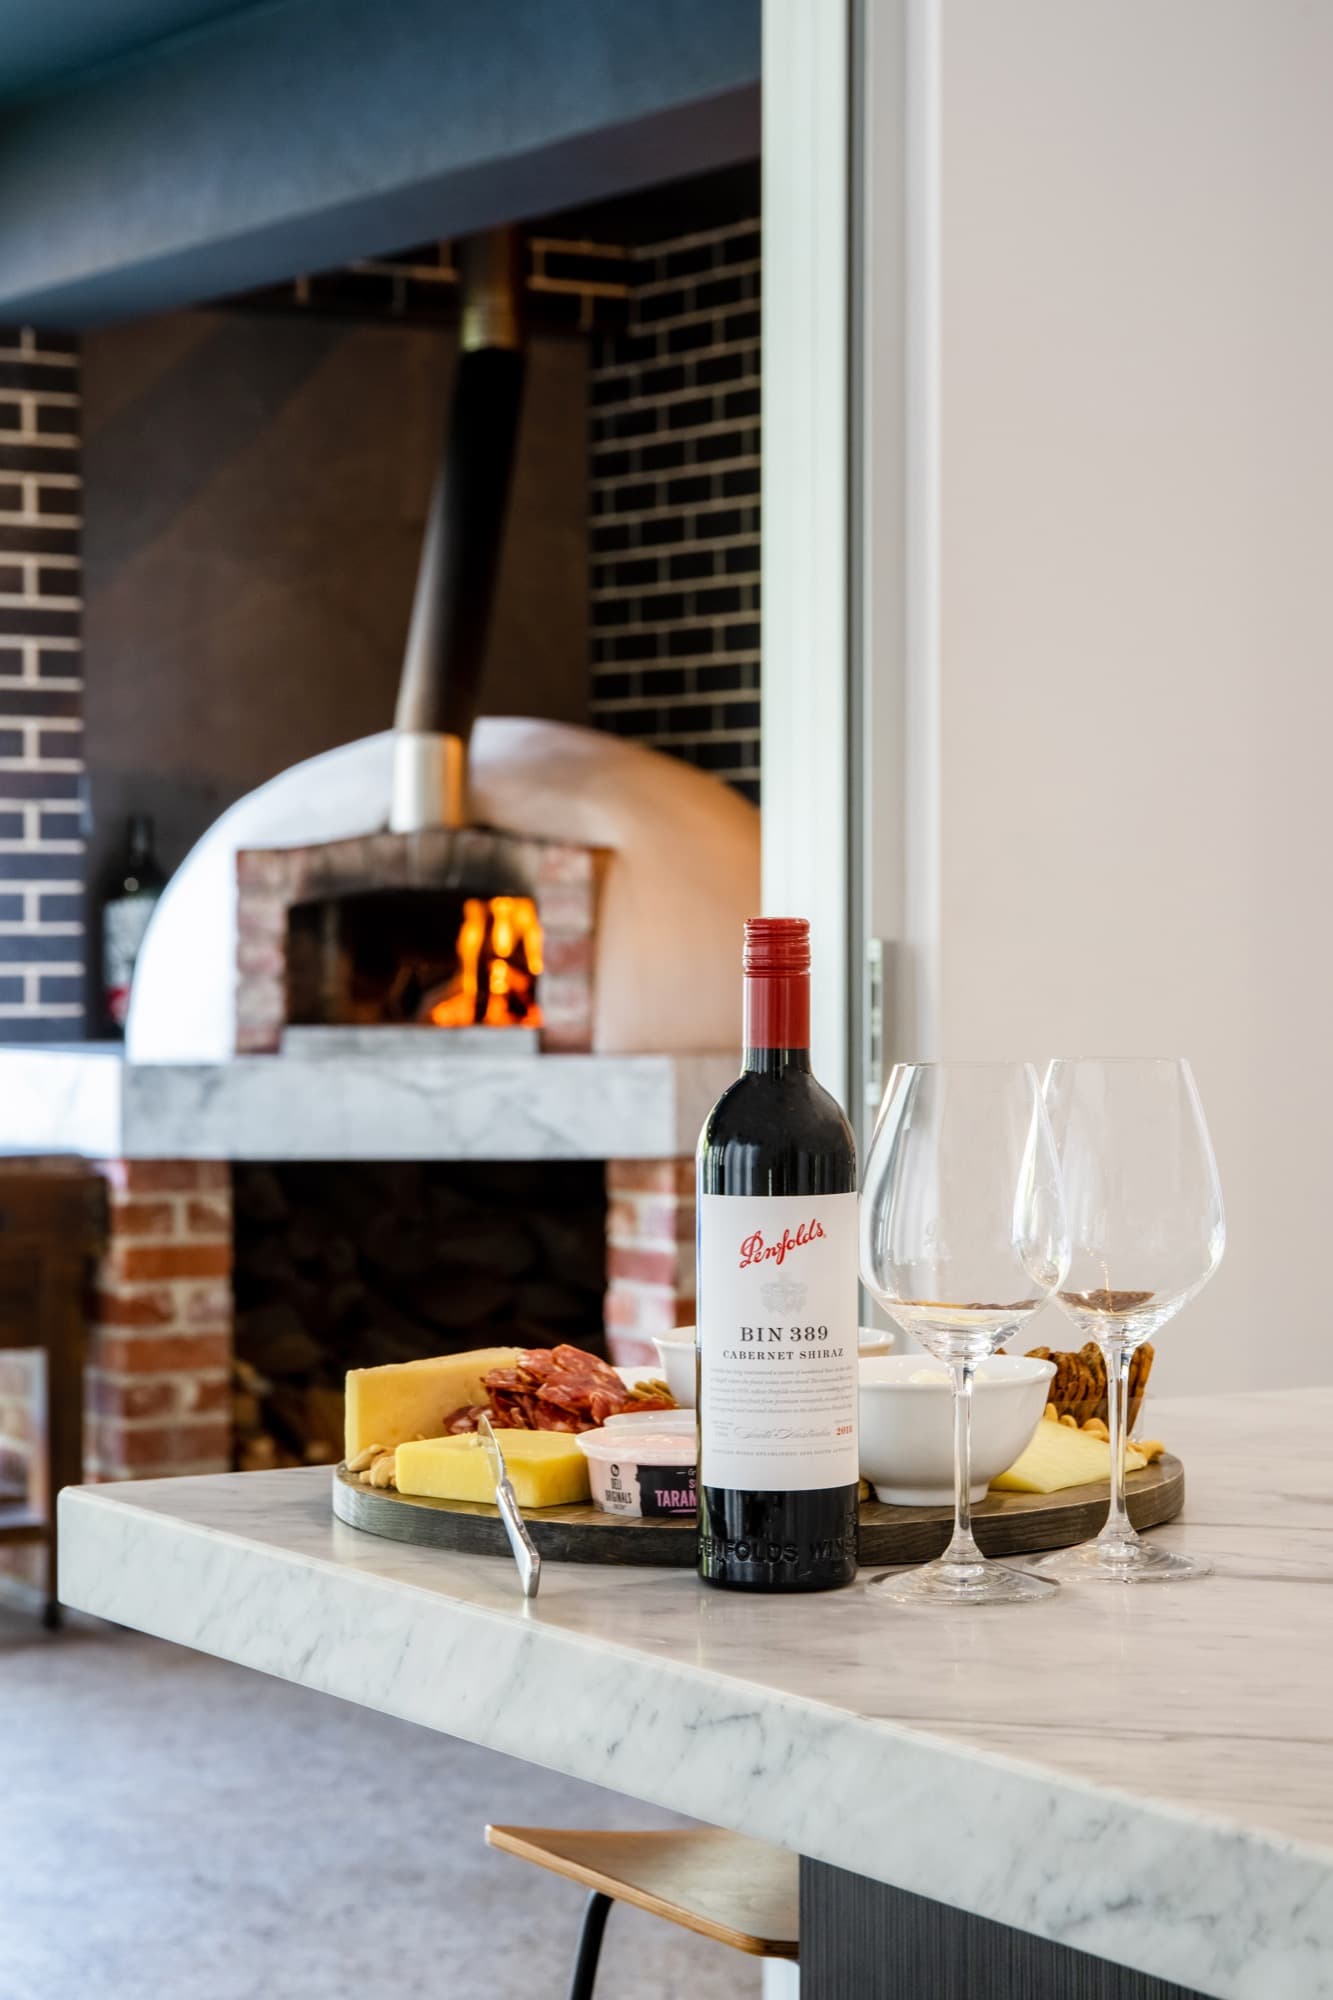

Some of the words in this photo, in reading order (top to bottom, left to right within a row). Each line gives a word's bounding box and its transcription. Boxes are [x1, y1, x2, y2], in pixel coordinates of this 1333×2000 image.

[739, 1218, 824, 1268] Penfolds
[740, 1326, 784, 1342] BIN
[790, 1325, 828, 1342] 389
[723, 1349, 794, 1360] CABERNET
[800, 1348, 843, 1359] SHIRAZ
